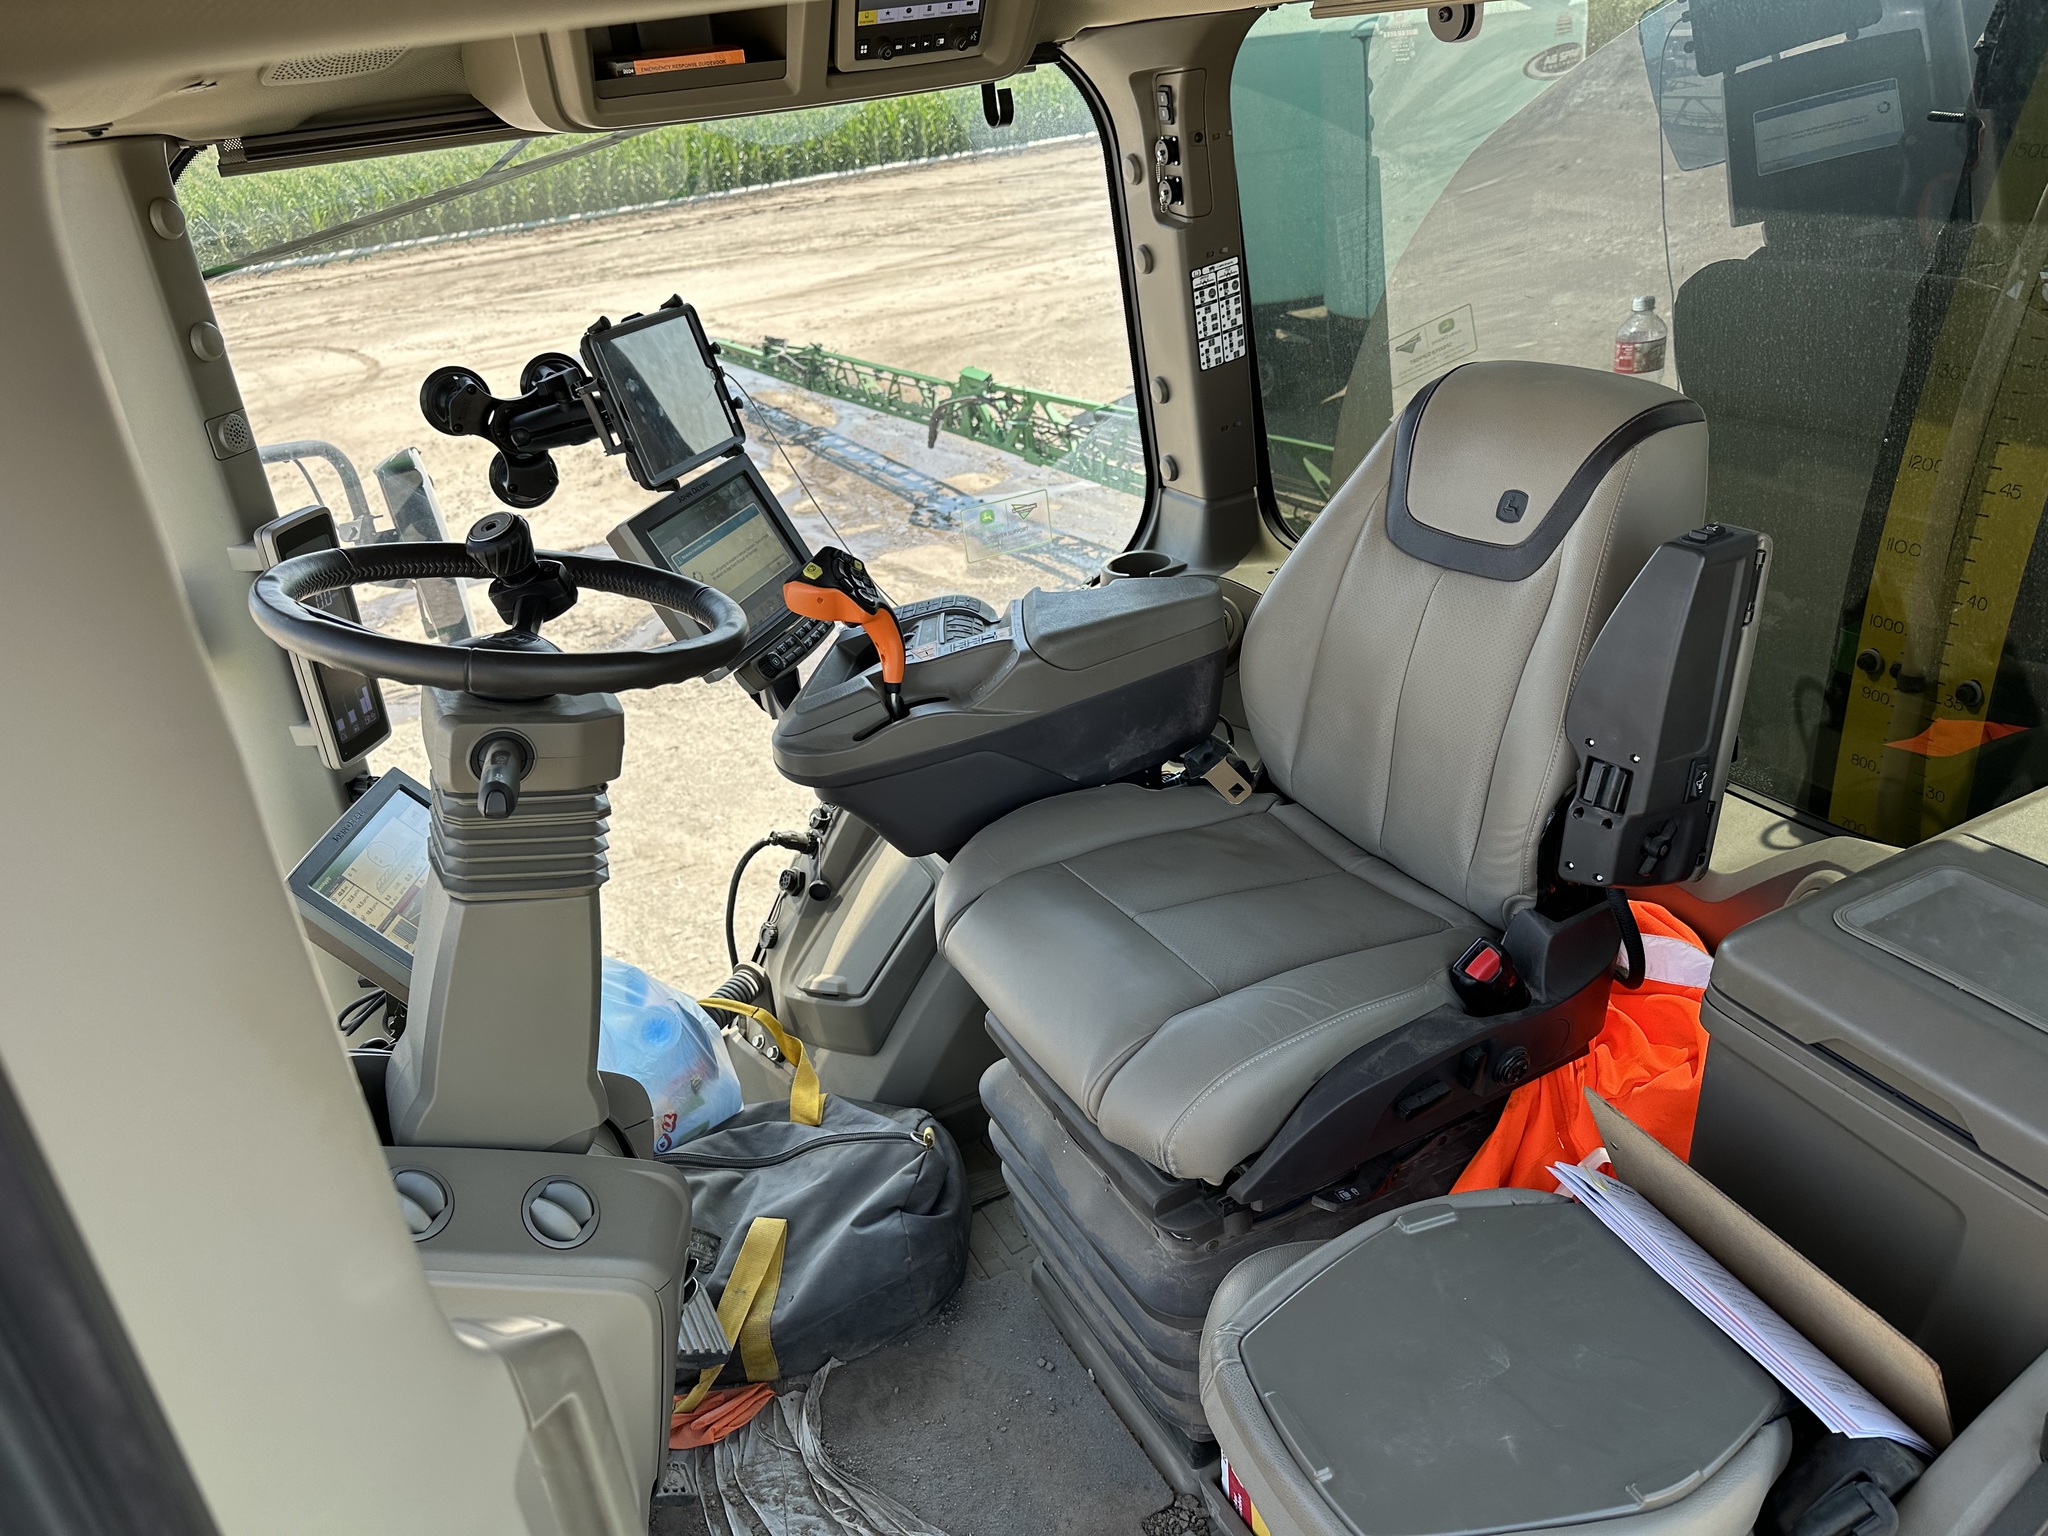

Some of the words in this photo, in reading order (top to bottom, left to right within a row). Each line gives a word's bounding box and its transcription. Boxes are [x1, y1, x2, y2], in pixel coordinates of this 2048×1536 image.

[641, 64, 671, 73] EMERGENCY
[698, 59, 727, 67] GUIDEBOOK
[678, 492, 693, 504] JOHN
[692, 480, 711, 495] DEERE
[2000, 483, 2023, 500] 45
[1007, 526, 1029, 536] SUPPORT
[1886, 537, 1922, 557] 1100
[1967, 595, 1988, 612] 40
[1869, 613, 1905, 634] 1000
[1861, 686, 1890, 706] 900
[1943, 694, 1964, 712] 35
[1851, 753, 1877, 773] 800
[1925, 785, 1946, 803] 30
[332, 826, 350, 843] JOHN
[345, 810, 366, 827] DEERE
